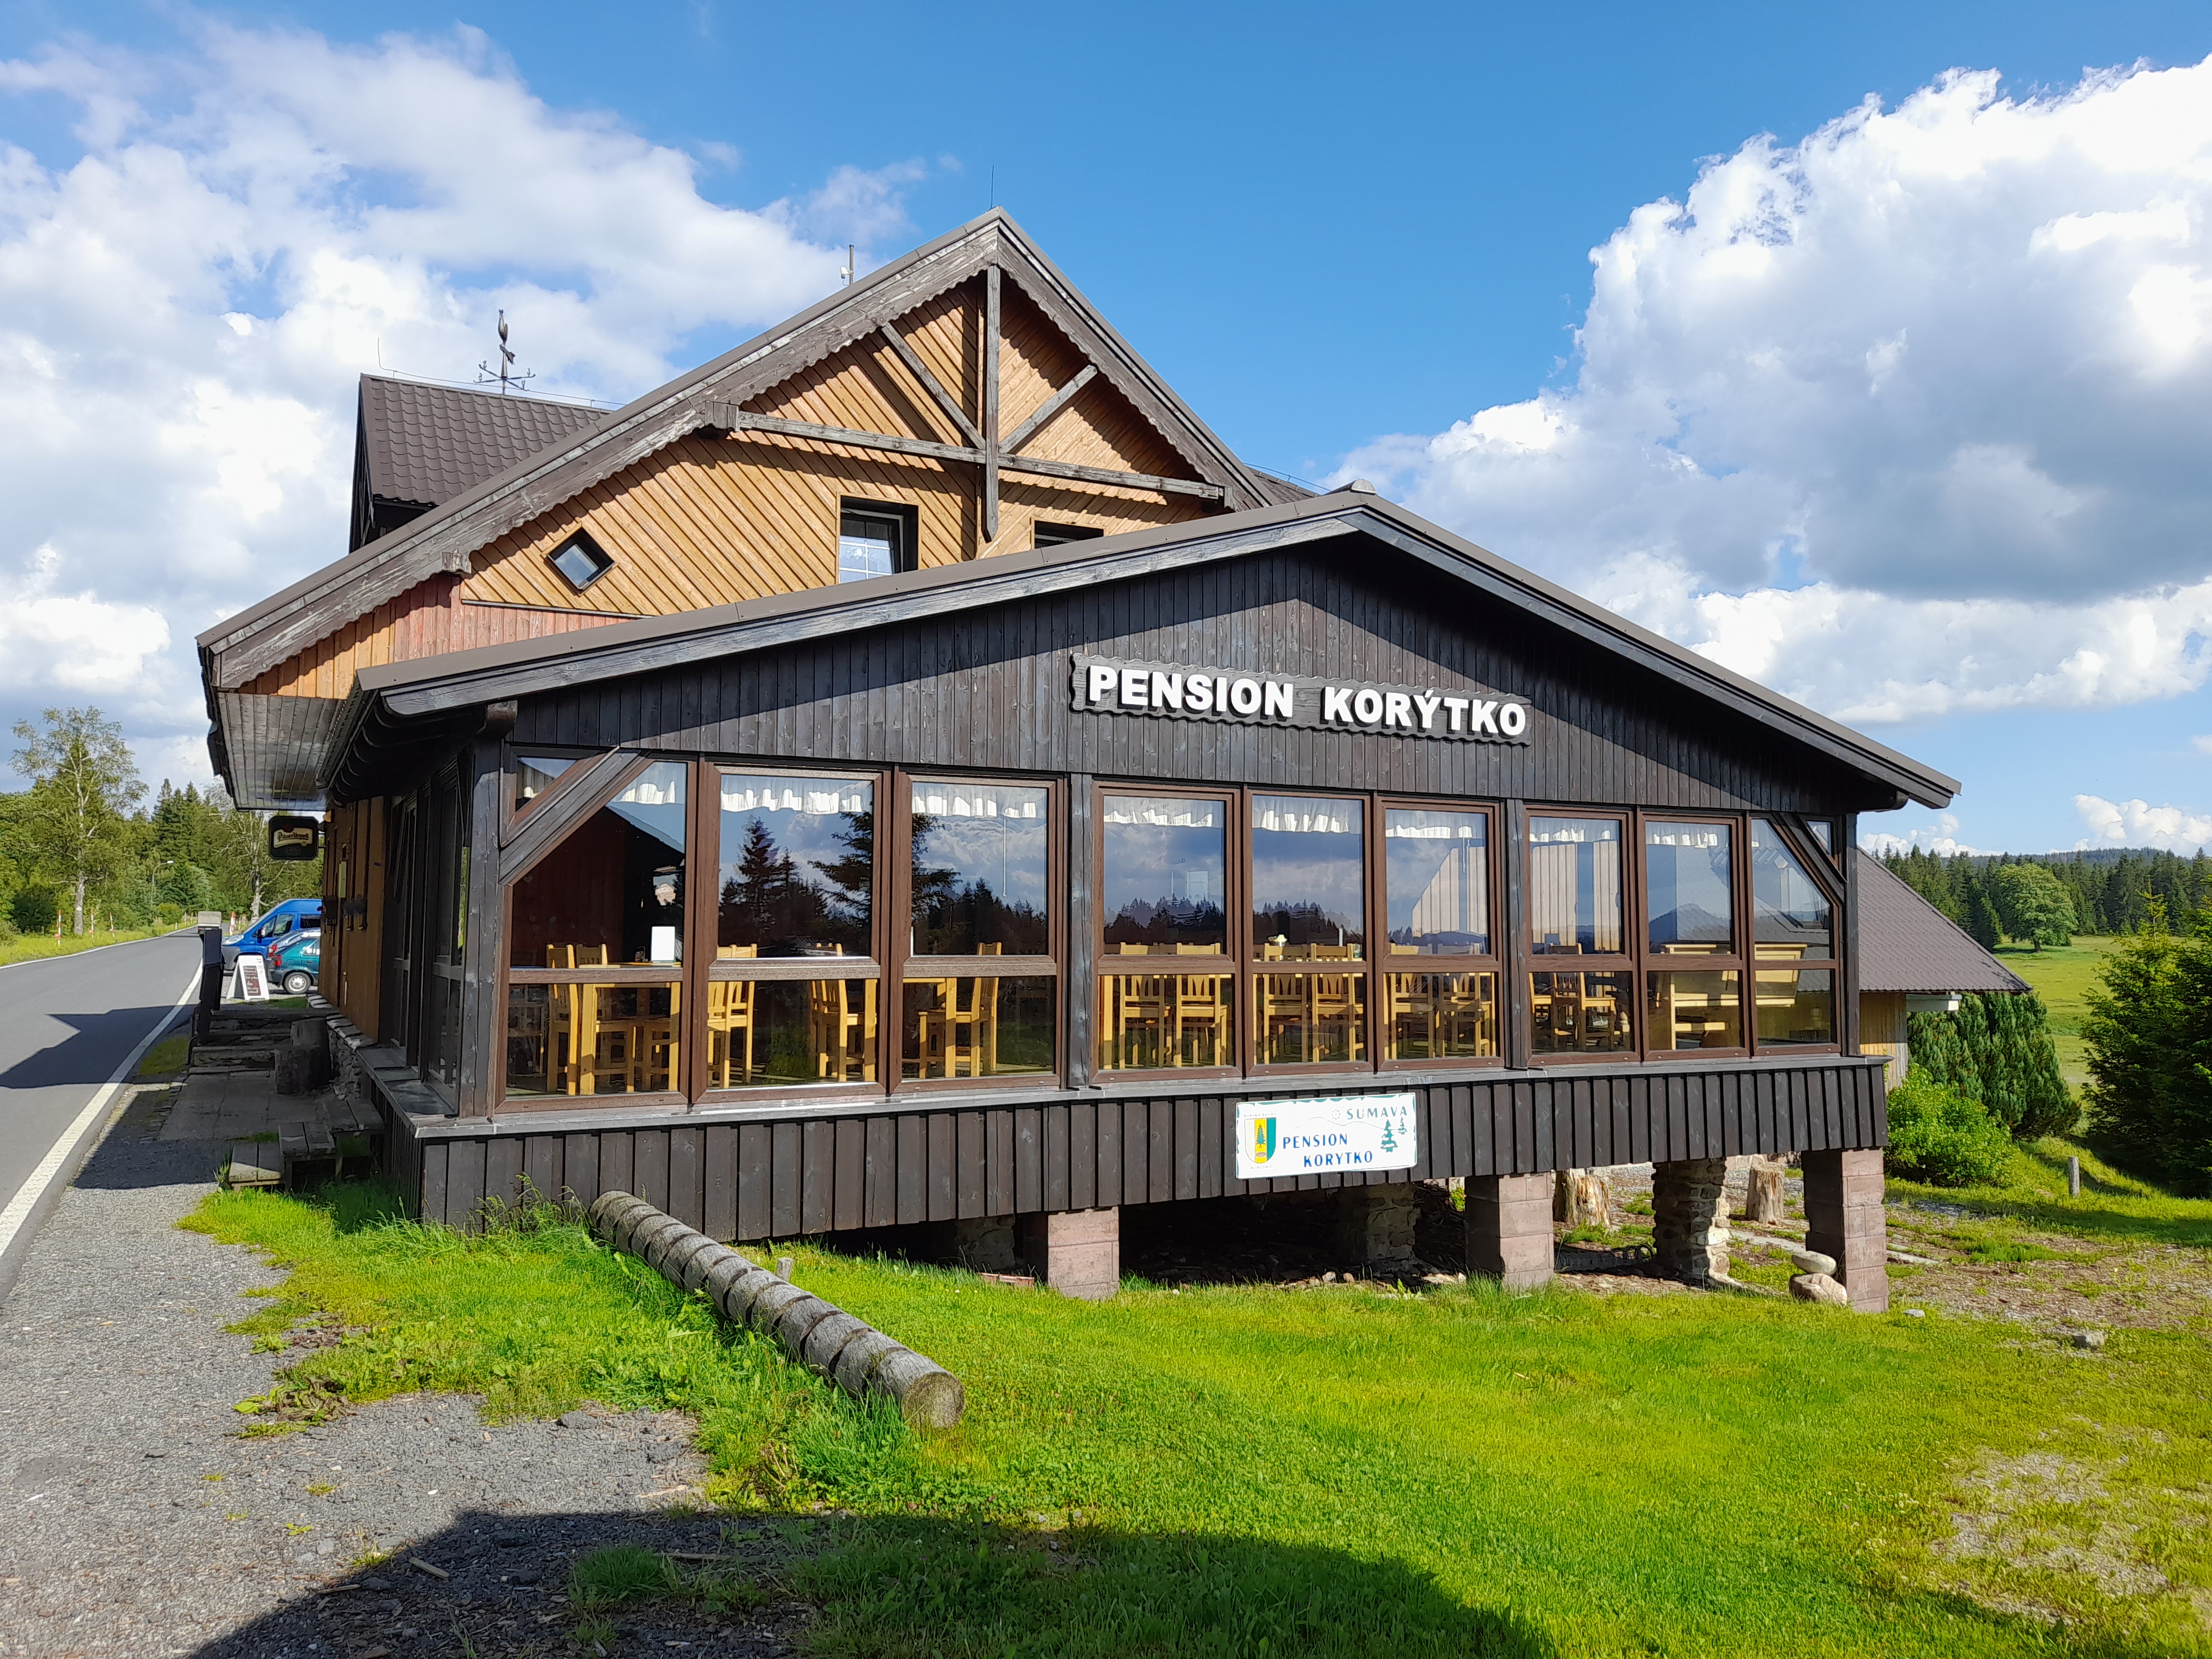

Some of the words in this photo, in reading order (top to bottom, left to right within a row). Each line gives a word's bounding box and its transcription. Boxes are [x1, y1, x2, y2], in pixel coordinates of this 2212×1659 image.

[1089, 664, 1293, 717] PENSION
[1324, 686, 1526, 735] KORÝTKO
[1282, 1133, 1348, 1149] PENSION
